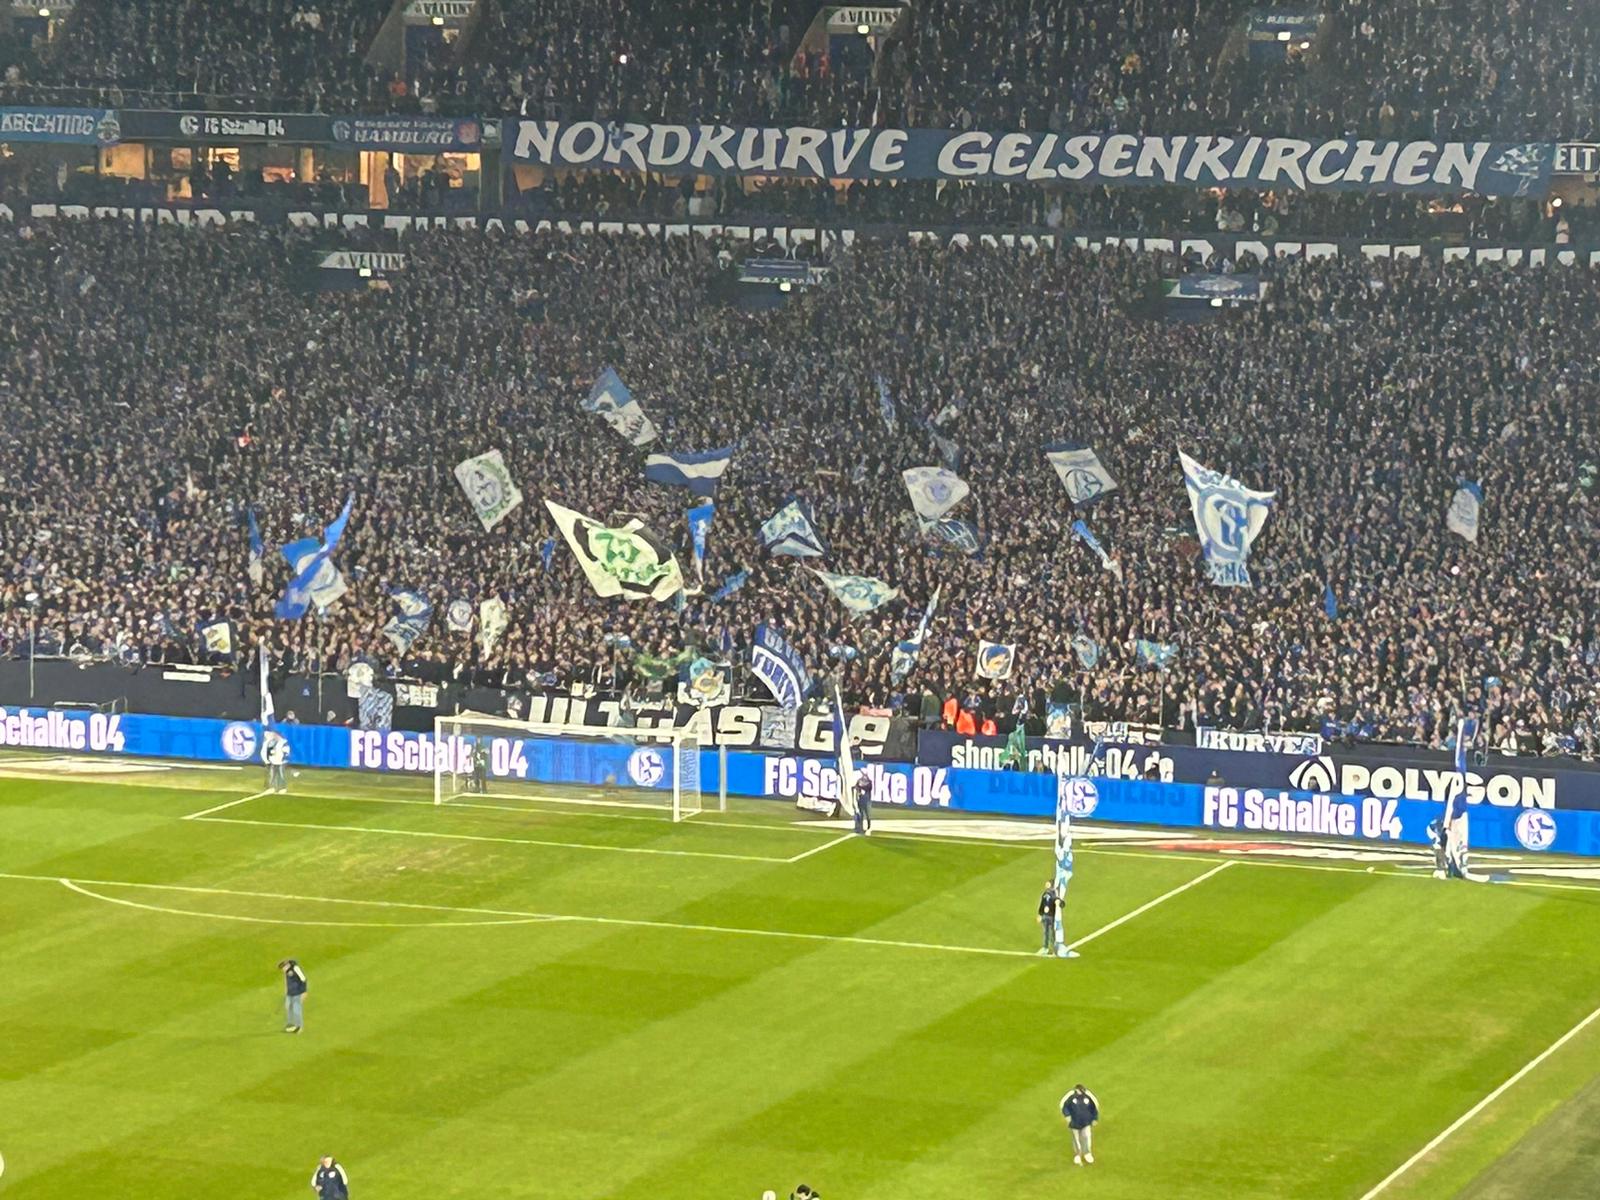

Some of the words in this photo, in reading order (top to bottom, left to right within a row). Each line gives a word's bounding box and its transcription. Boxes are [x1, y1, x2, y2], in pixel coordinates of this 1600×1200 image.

[513, 118, 909, 178] NORDKURVE
[937, 132, 1491, 190] GELSENKIRCHEN
[90, 713, 125, 752] 04
[351, 730, 382, 770] FC
[387, 731, 475, 774] Schalk
[491, 738, 528, 778] 04
[765, 757, 797, 797] FC
[913, 766, 951, 807] 04
[1203, 786, 1240, 827] FC
[1243, 789, 1355, 836] Schalke
[1362, 797, 1403, 840] 04
